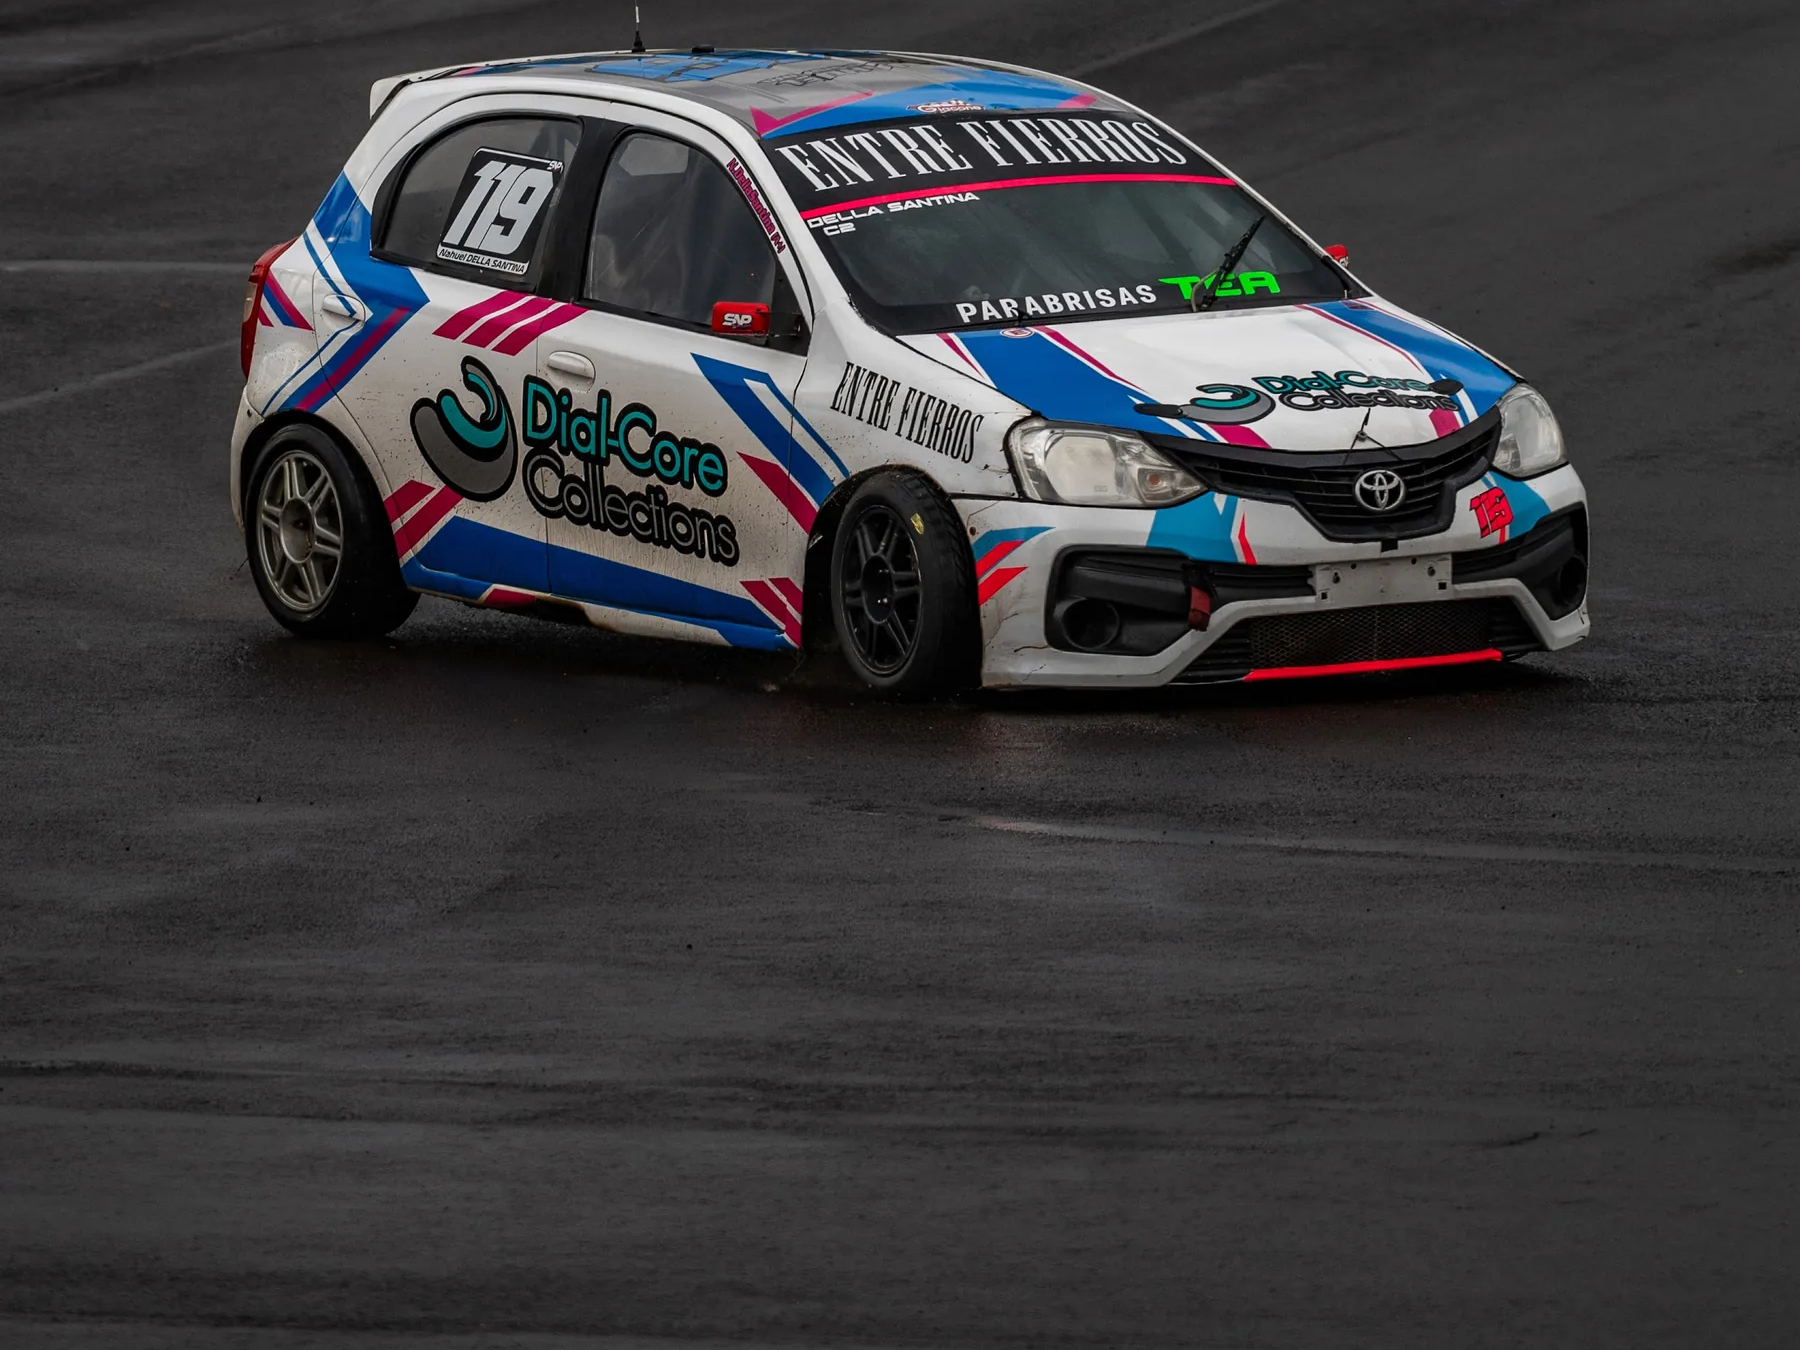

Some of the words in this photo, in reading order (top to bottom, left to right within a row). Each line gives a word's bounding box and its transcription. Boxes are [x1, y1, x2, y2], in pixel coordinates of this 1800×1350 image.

[774, 124, 973, 192] ENTRE
[956, 118, 1187, 167] FIERROS
[443, 161, 554, 255] 119
[806, 205, 884, 229] DELLA
[887, 192, 981, 213] SANTINA
[823, 222, 857, 237] C2
[438, 248, 467, 261] Nahuel
[466, 254, 490, 267] DELLA
[491, 259, 526, 273] SANTINA
[956, 284, 1157, 323] PARABRISAS
[1252, 370, 1434, 394] Dial-Core
[1279, 389, 1462, 411] Collections
[830, 361, 902, 432] ENTRE
[895, 386, 985, 465] FIERROS
[523, 375, 728, 498] Dial-Core
[523, 447, 740, 567] Collections
